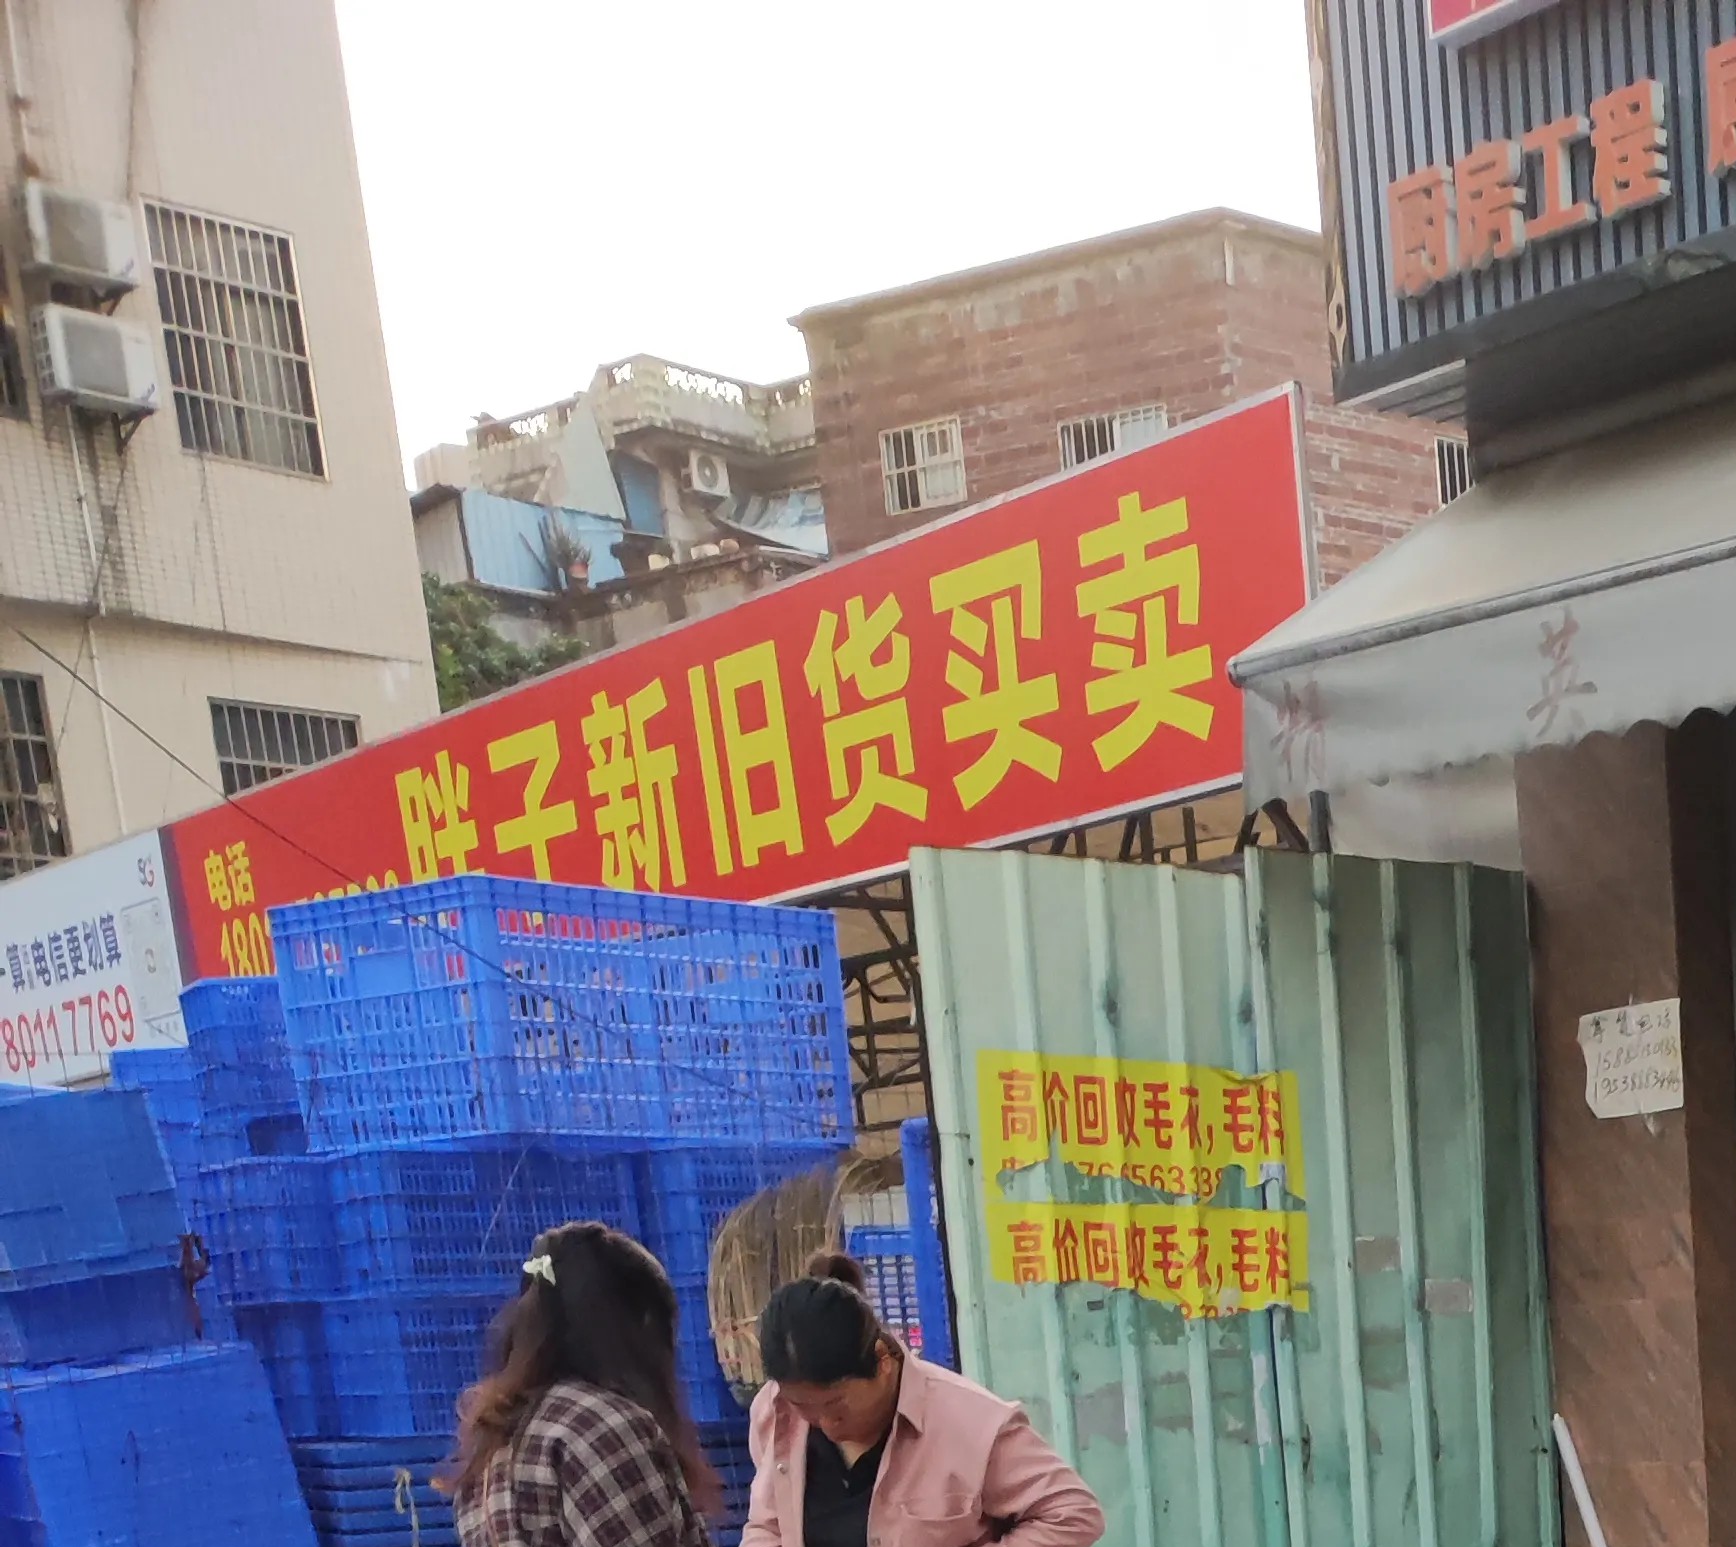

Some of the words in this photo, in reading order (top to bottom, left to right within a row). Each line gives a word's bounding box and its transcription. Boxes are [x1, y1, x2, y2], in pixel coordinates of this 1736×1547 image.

[1388, 78, 1670, 298] 厨房工程
[395, 490, 1215, 892] 胖子新旧货买卖
[204, 840, 255, 911] 电话
[0, 984, 134, 1073] 80117769
